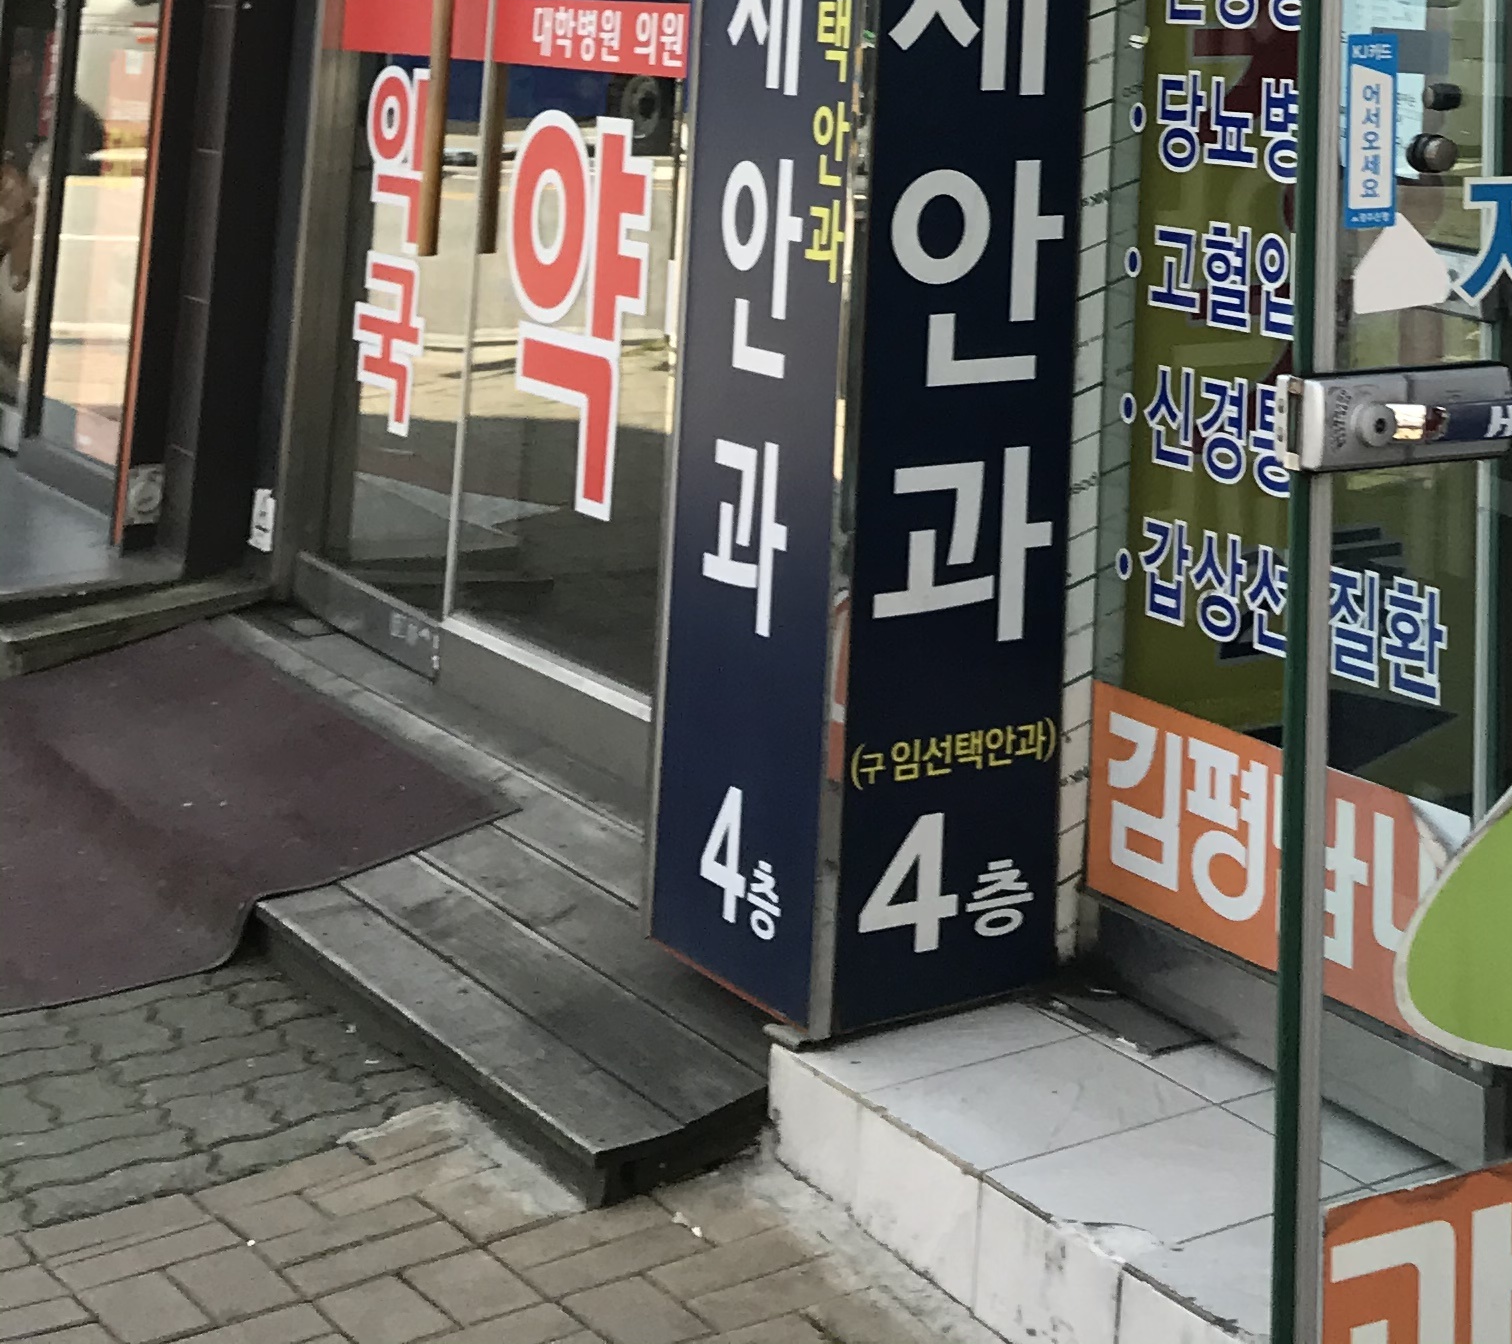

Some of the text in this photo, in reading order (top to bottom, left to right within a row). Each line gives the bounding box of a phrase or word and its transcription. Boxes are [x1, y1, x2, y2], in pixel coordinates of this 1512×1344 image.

[532, 6, 685, 68] 대학병원 의원
[698, 786, 781, 940] 4층
[858, 812, 1033, 953] 4층
